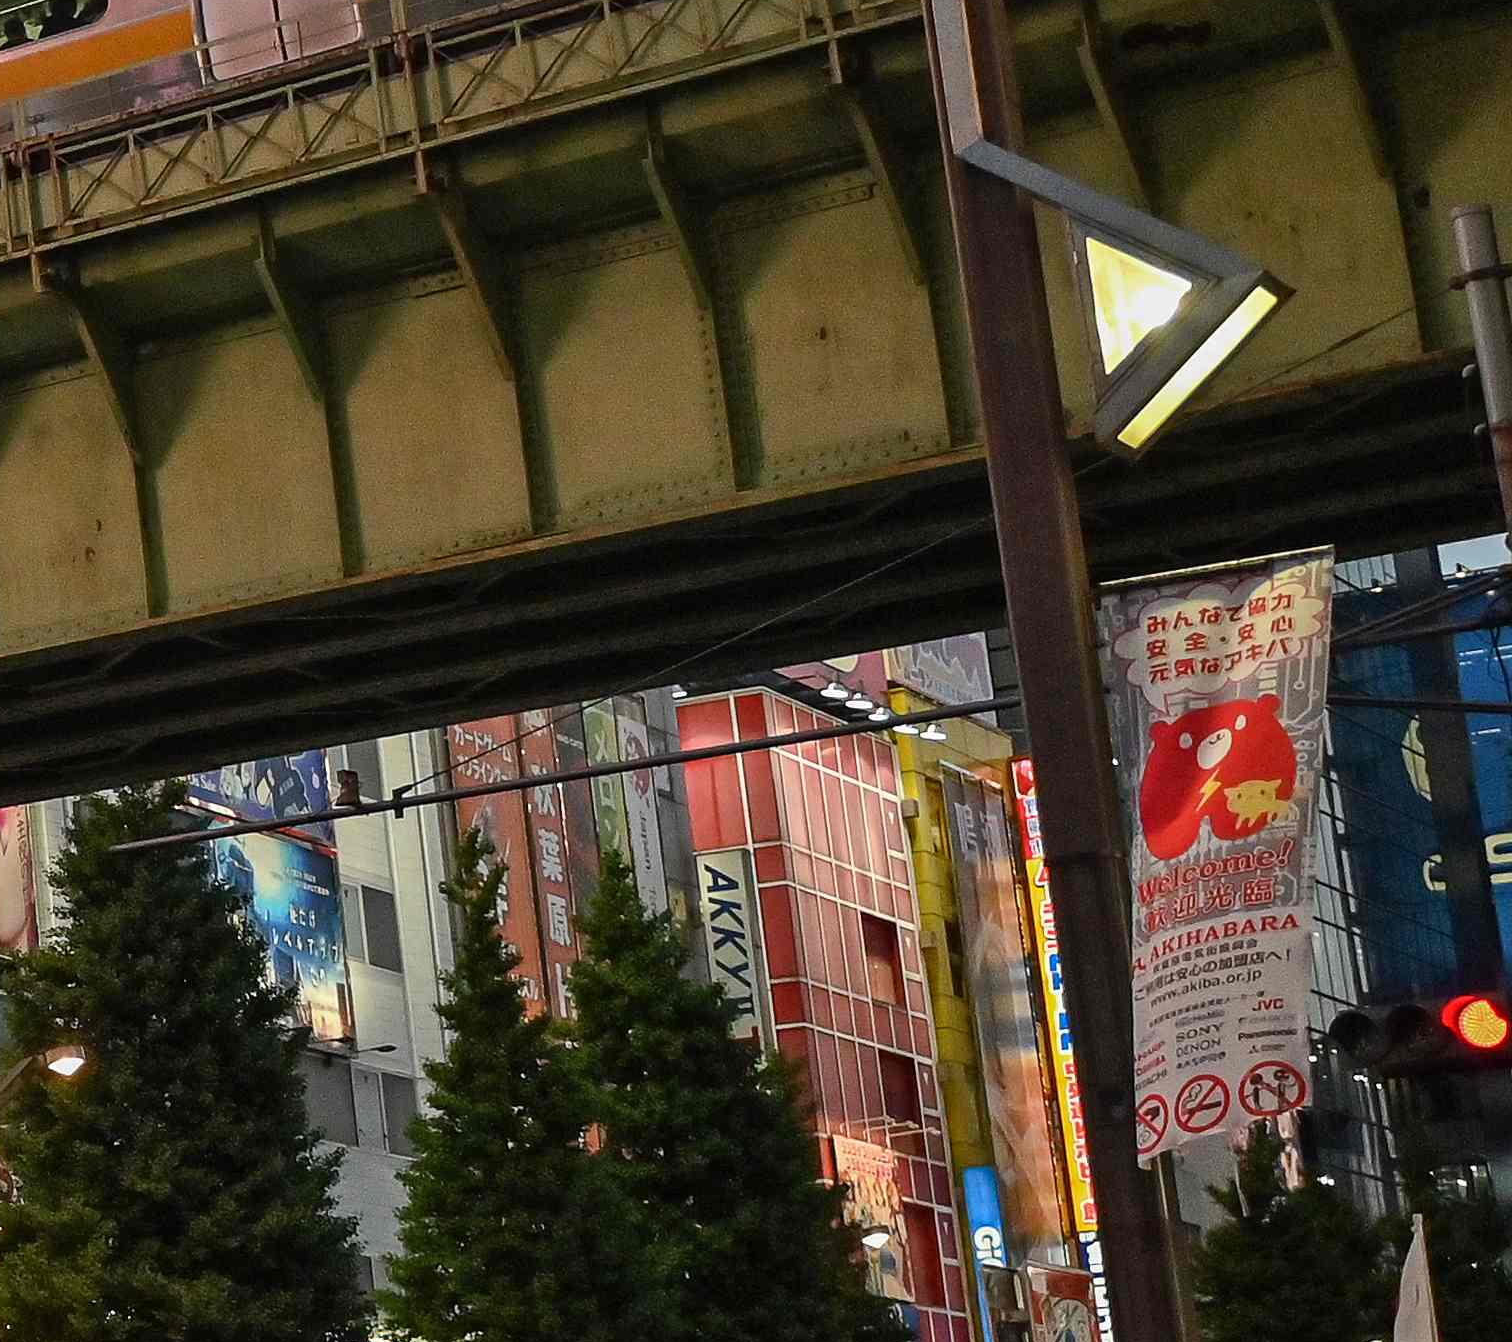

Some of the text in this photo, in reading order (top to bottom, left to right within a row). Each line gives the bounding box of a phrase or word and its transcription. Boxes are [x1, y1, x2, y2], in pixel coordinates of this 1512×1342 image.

[1147, 592, 1294, 635] みんなで協力
[1148, 636, 1290, 684] 元気なアキバ
[1137, 837, 1295, 907] Welcome!
[1149, 913, 1300, 962] AKIHABARA
[1251, 997, 1285, 1012] JVC
[1175, 1022, 1224, 1043] SONY
[1175, 1038, 1222, 1058] DENON
